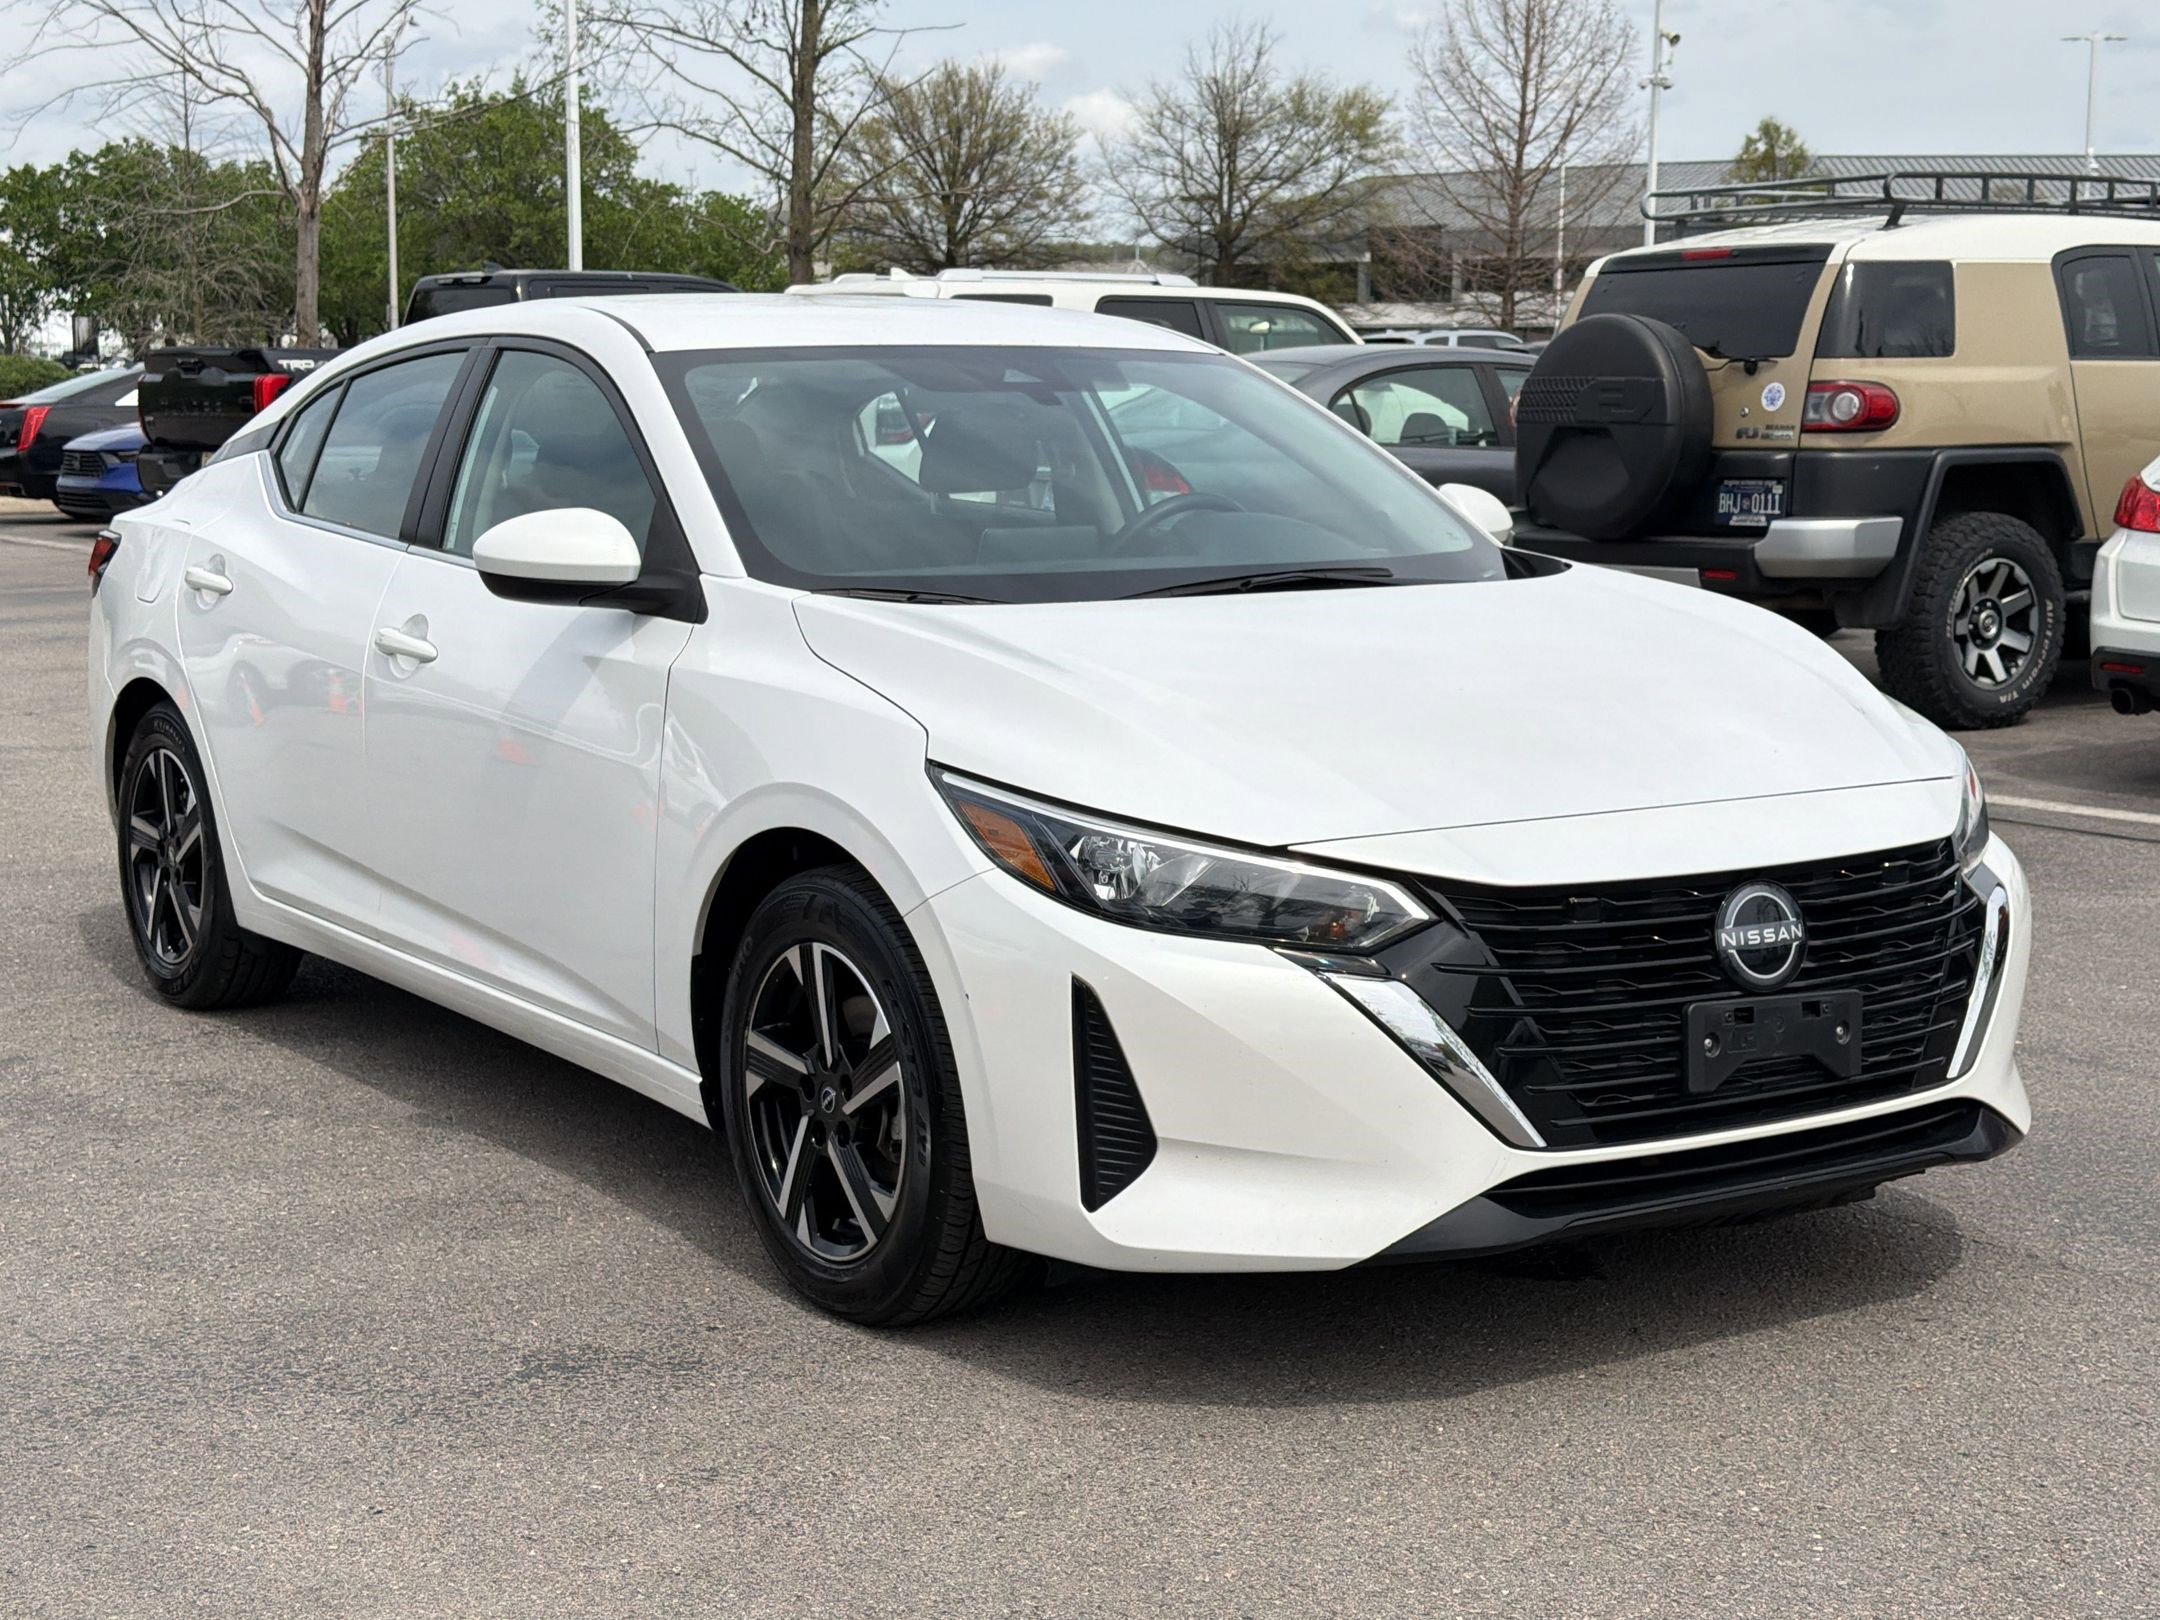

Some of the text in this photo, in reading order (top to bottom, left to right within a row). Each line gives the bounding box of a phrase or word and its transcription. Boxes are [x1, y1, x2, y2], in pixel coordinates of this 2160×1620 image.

[277, 359, 315, 373] TRD
[1718, 492, 1781, 515] BHJ 0111
[1721, 922, 1803, 948] NISSAN
